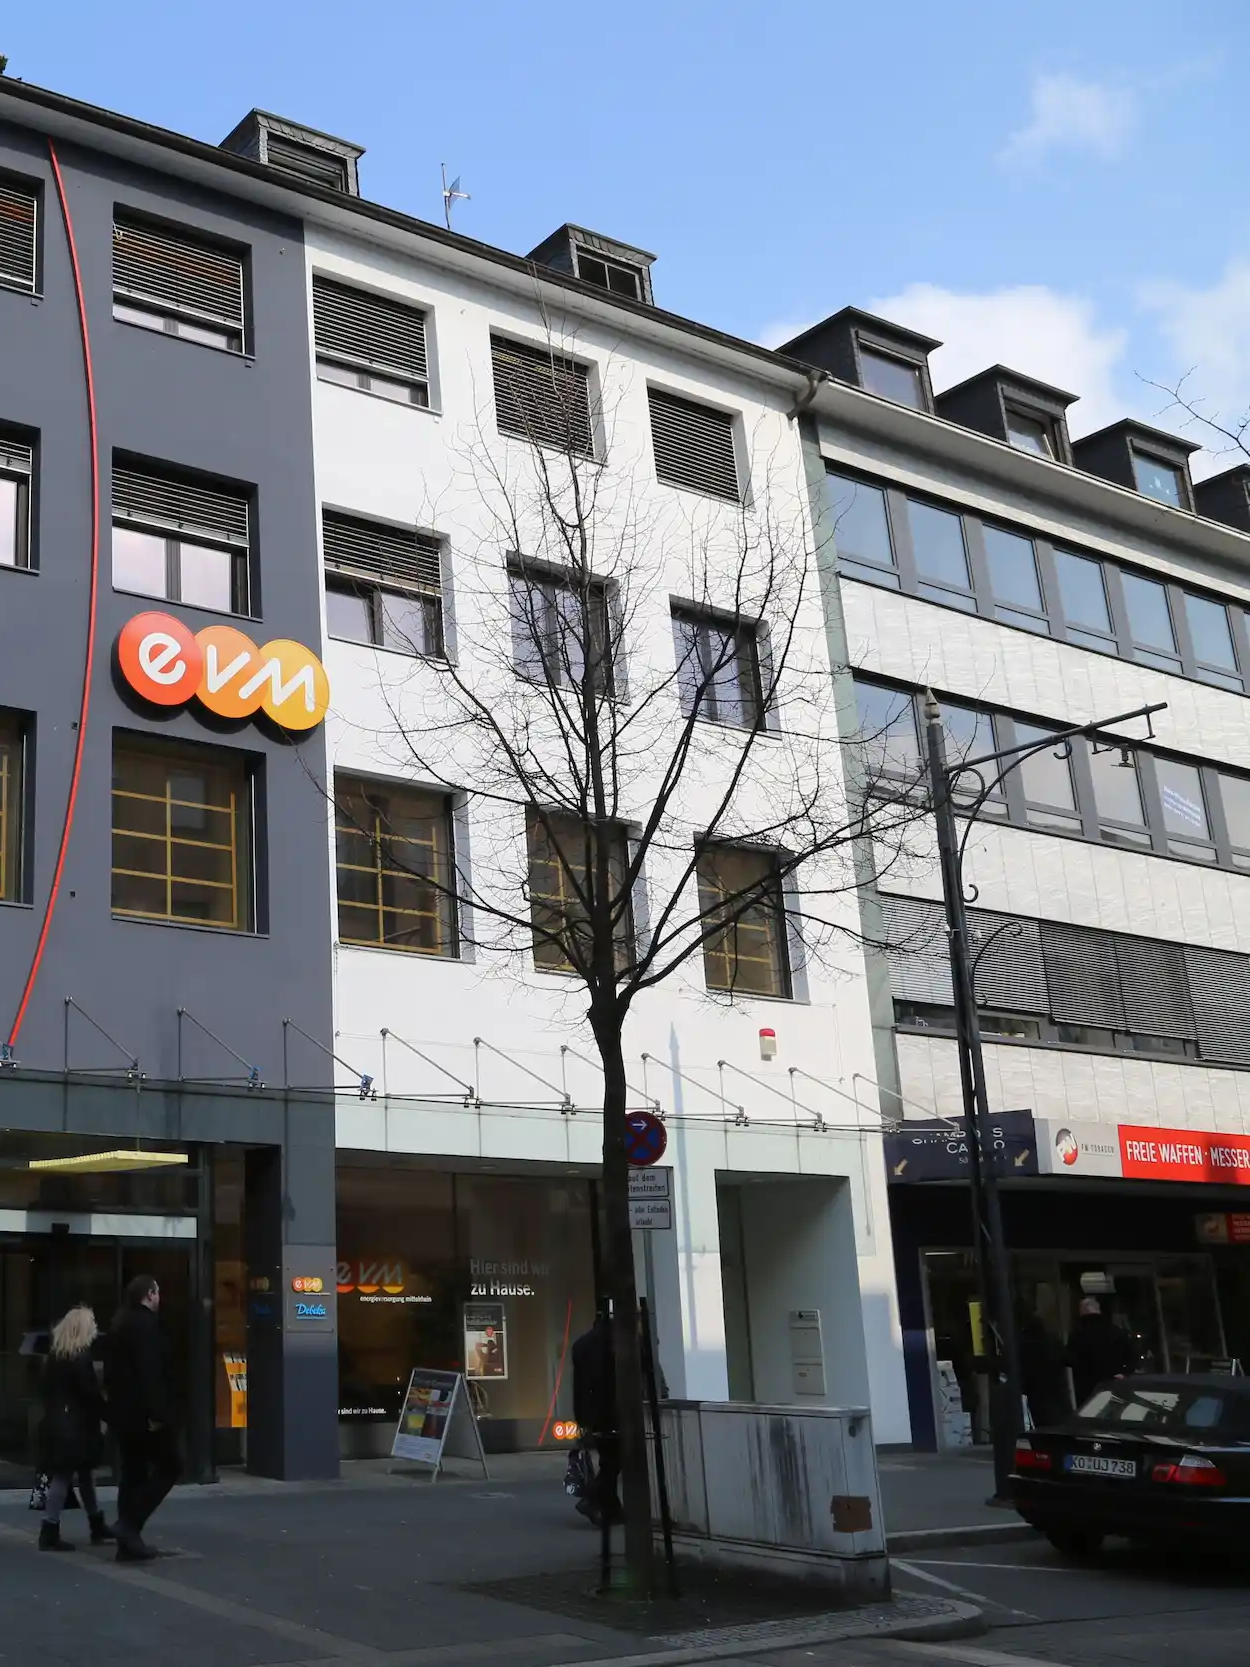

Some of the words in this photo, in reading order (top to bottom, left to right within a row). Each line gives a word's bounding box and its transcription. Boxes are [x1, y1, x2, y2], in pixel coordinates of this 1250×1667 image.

[138, 632, 316, 713] evm
[1126, 1140, 1158, 1164] FREIE
[1158, 1143, 1203, 1166] WAFFEN
[1209, 1146, 1250, 1169] MESSER
[470, 1259, 497, 1275] Hier
[500, 1259, 529, 1276] sind
[470, 1283, 487, 1296] zu
[490, 1279, 535, 1296] Hause.
[295, 1303, 327, 1316] Debeka
